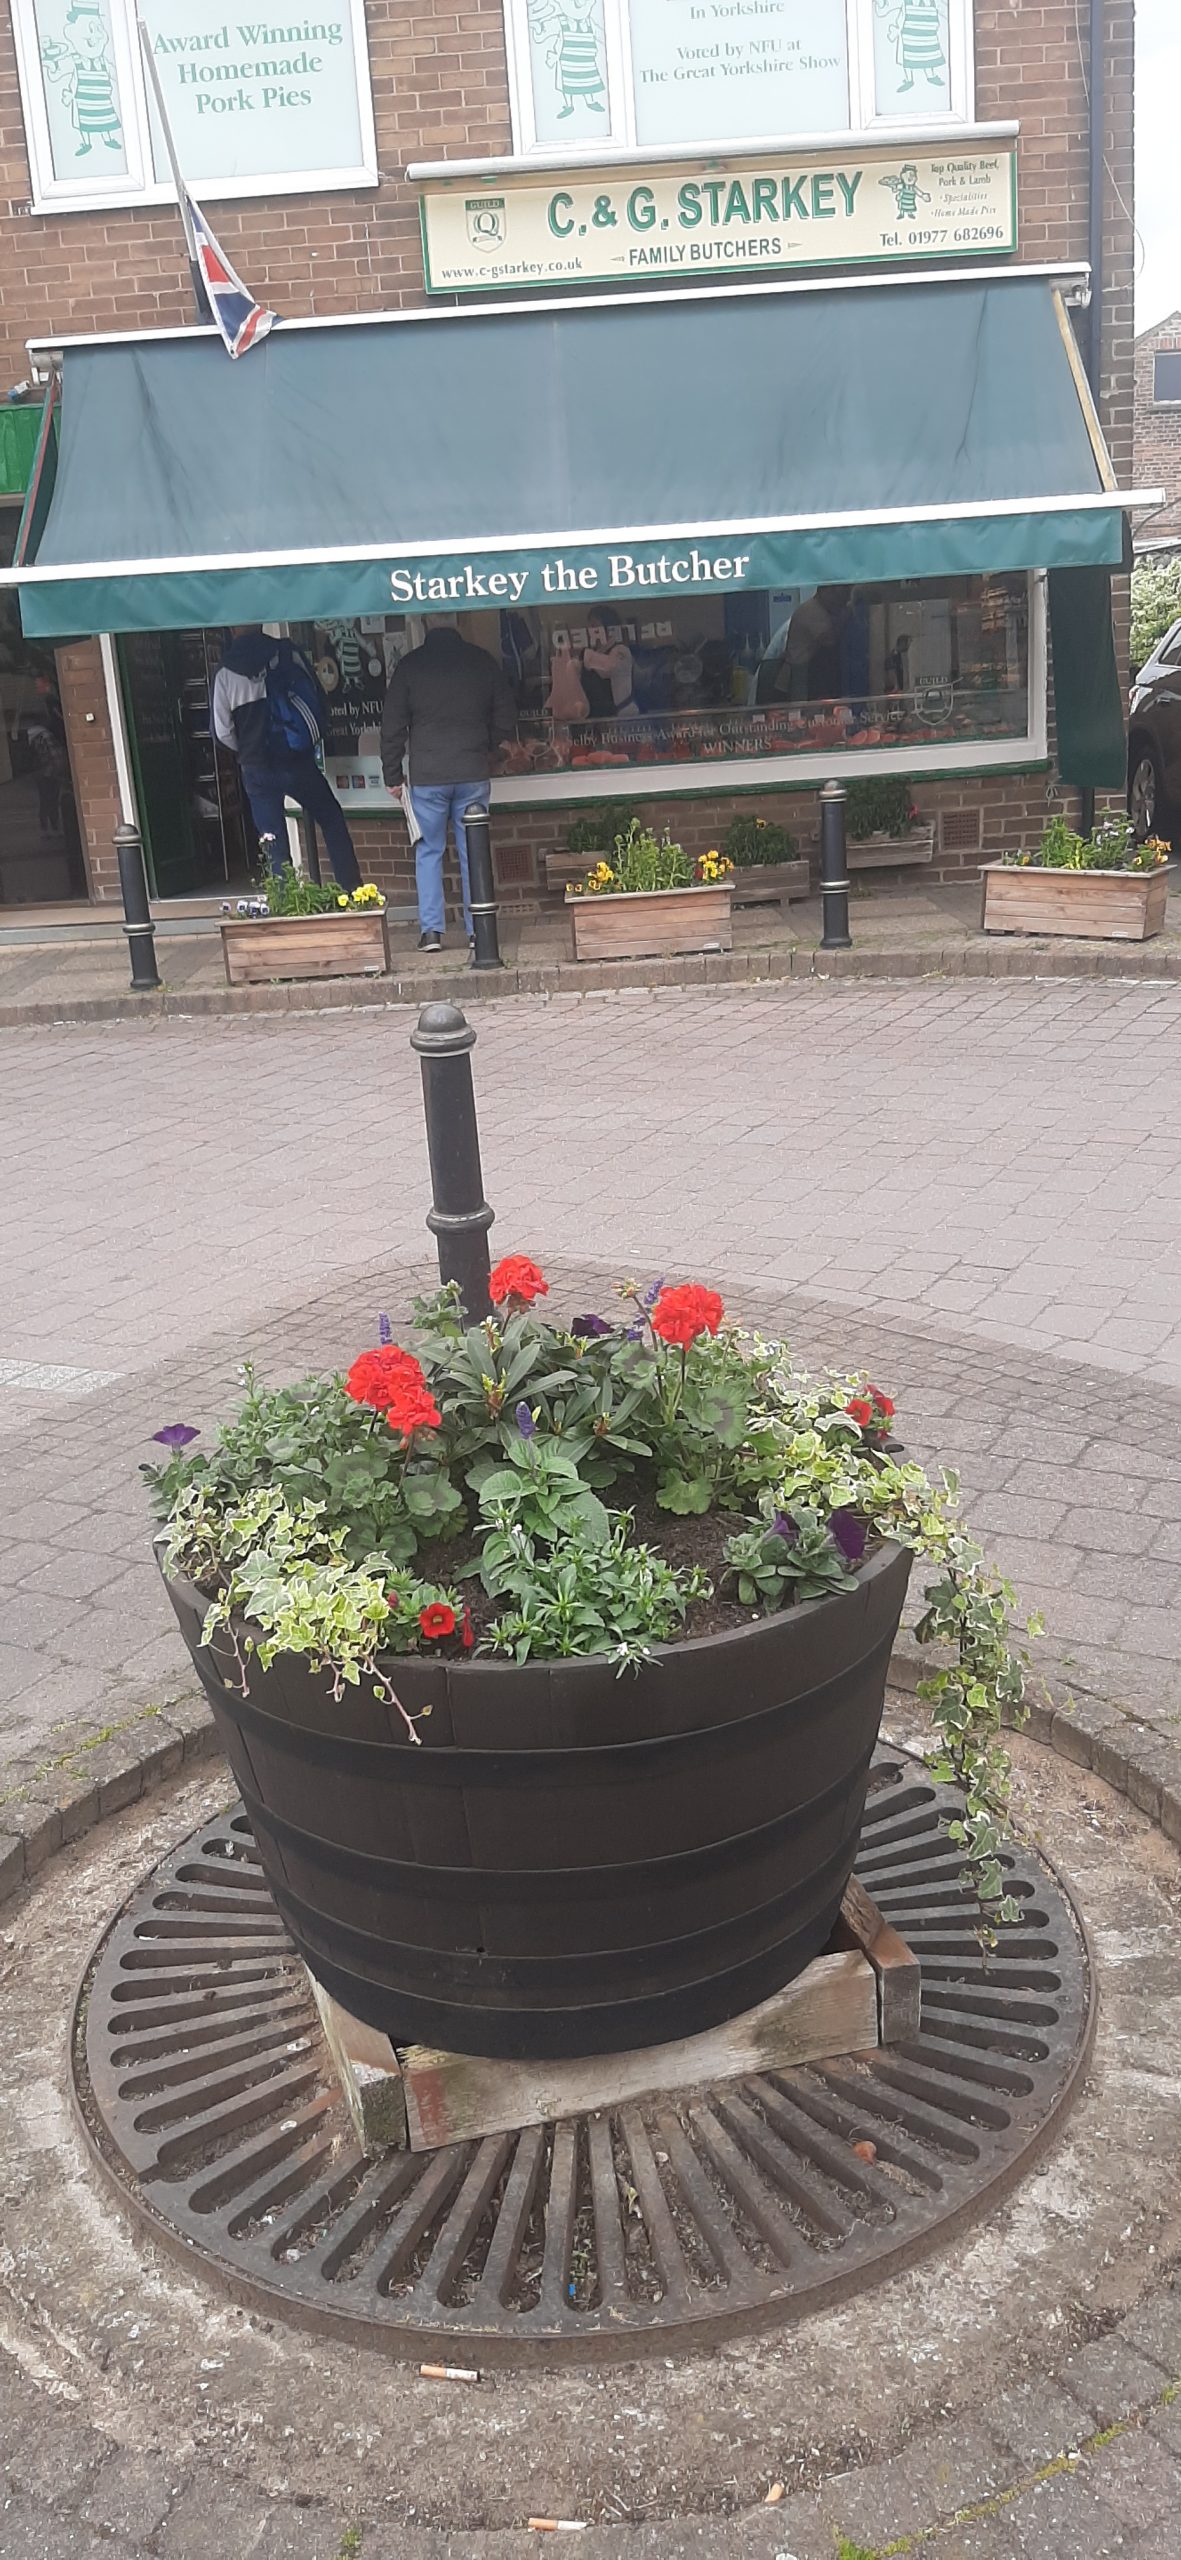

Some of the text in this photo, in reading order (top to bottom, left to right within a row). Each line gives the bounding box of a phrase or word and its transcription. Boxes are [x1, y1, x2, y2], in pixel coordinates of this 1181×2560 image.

[690, 1, 785, 20] In Yorkshire
[153, 20, 343, 54] Award Winning
[677, 39, 802, 60] Voted by NFU at
[177, 52, 322, 84] Homemade
[640, 56, 841, 83] The Great Yorkshire Show
[195, 86, 312, 114] Pork Pies
[947, 161, 977, 174] Quality
[939, 174, 991, 187] Pork & Lamb
[470, 200, 500, 209] GUILD
[591, 195, 618, 228] &
[678, 170, 863, 229] STARKEY
[880, 226, 1004, 247] Tel. 01977 682696
[629, 237, 782, 266] FAMILY BUTCHERS
[441, 257, 583, 280] www.c-gstarkey.co.uk
[390, 550, 750, 602] Starkey the Butcher
[349, 701, 360, 719] by
[361, 700, 384, 715] NFU
[703, 738, 772, 755] WINNERS
